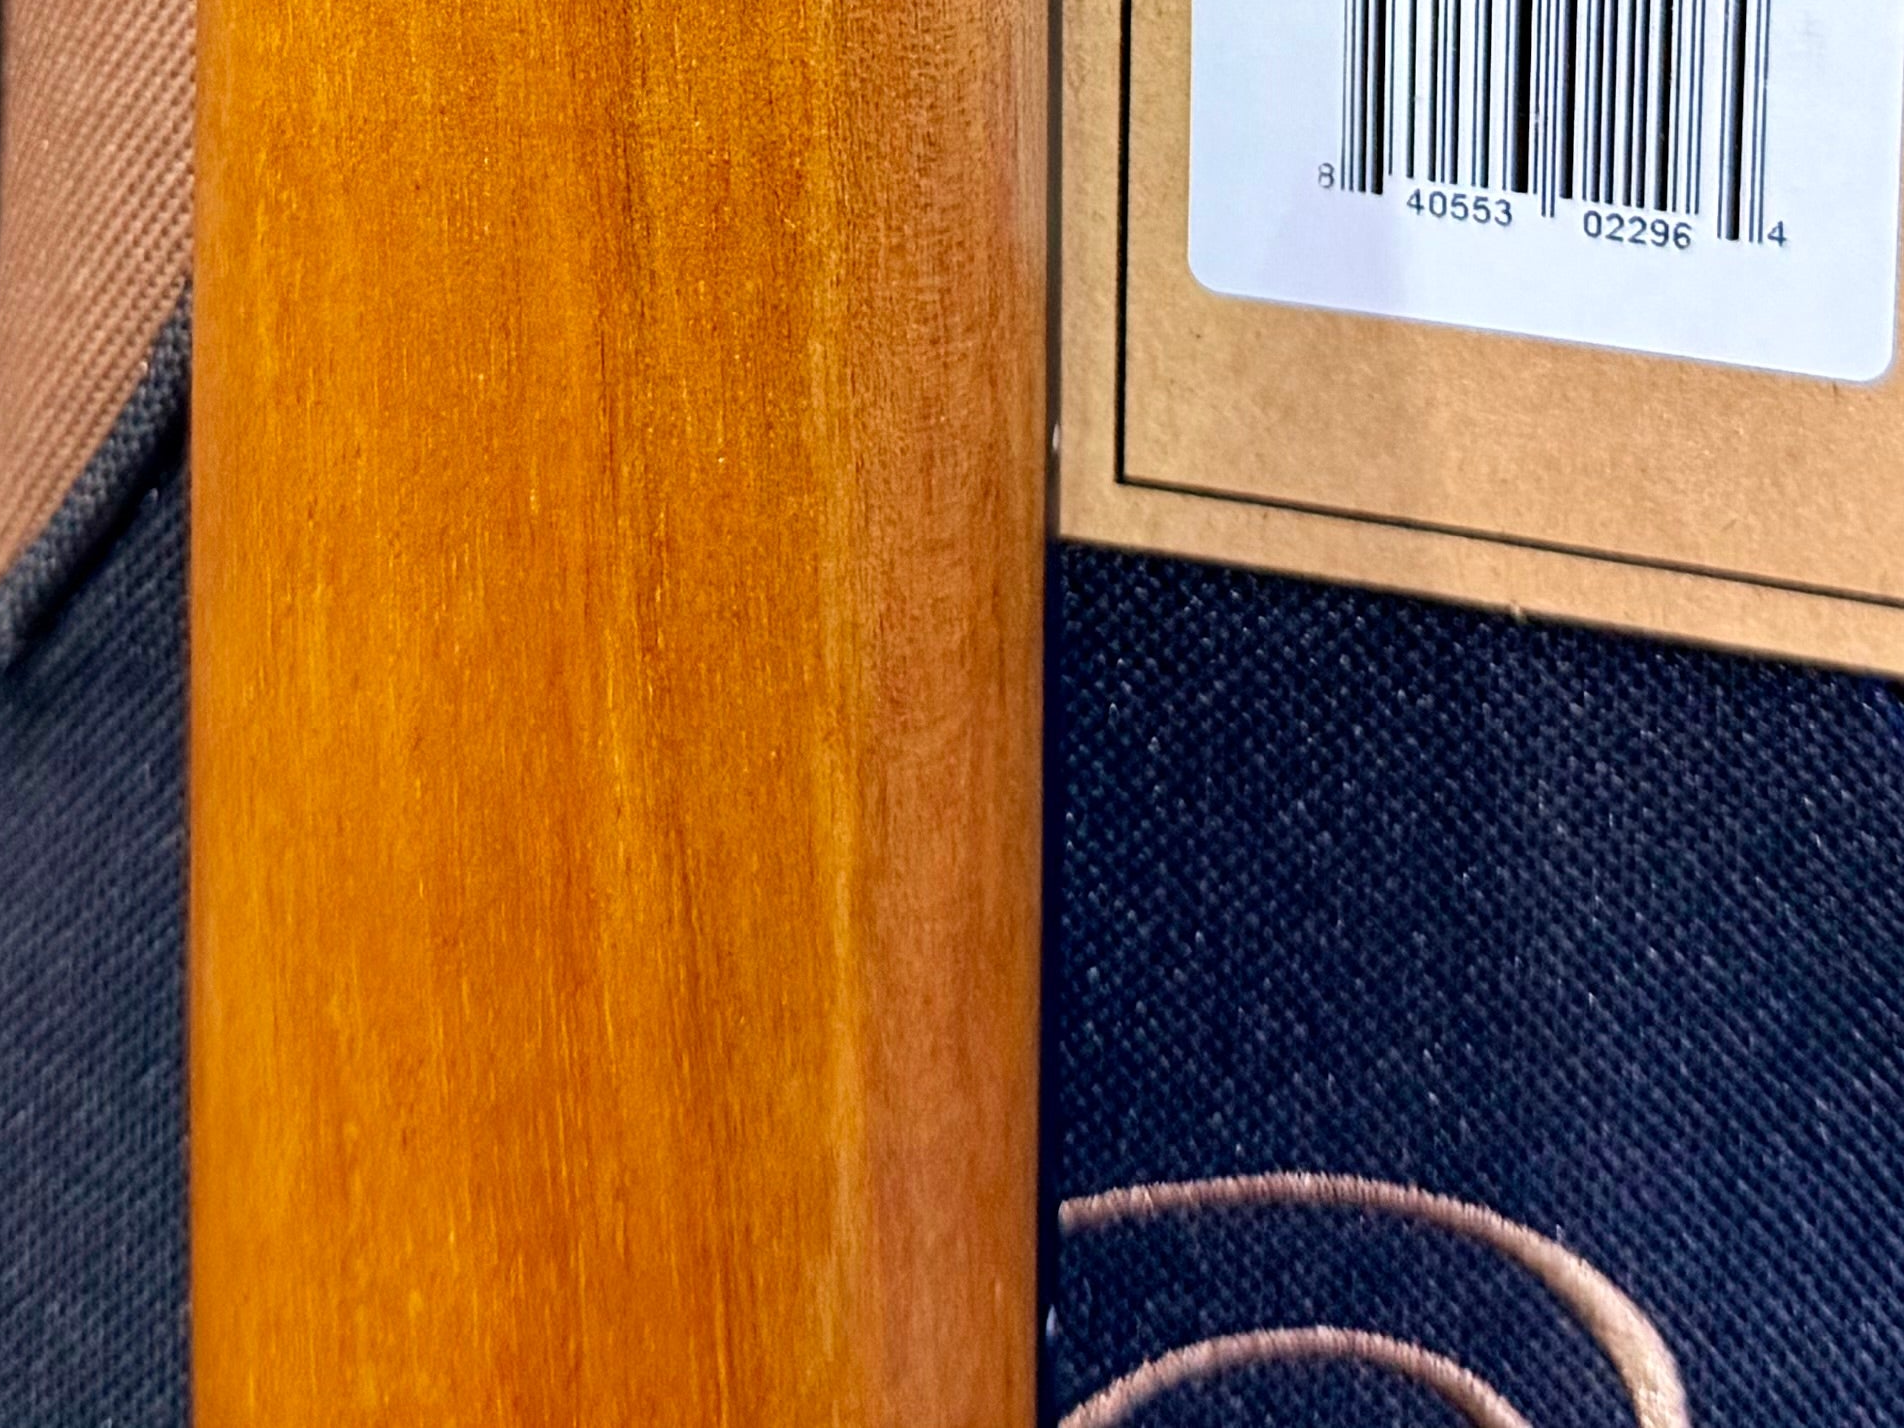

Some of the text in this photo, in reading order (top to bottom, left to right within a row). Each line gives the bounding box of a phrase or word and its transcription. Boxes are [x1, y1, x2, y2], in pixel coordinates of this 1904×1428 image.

[1317, 163, 1788, 250] 8 40553 02296 4
